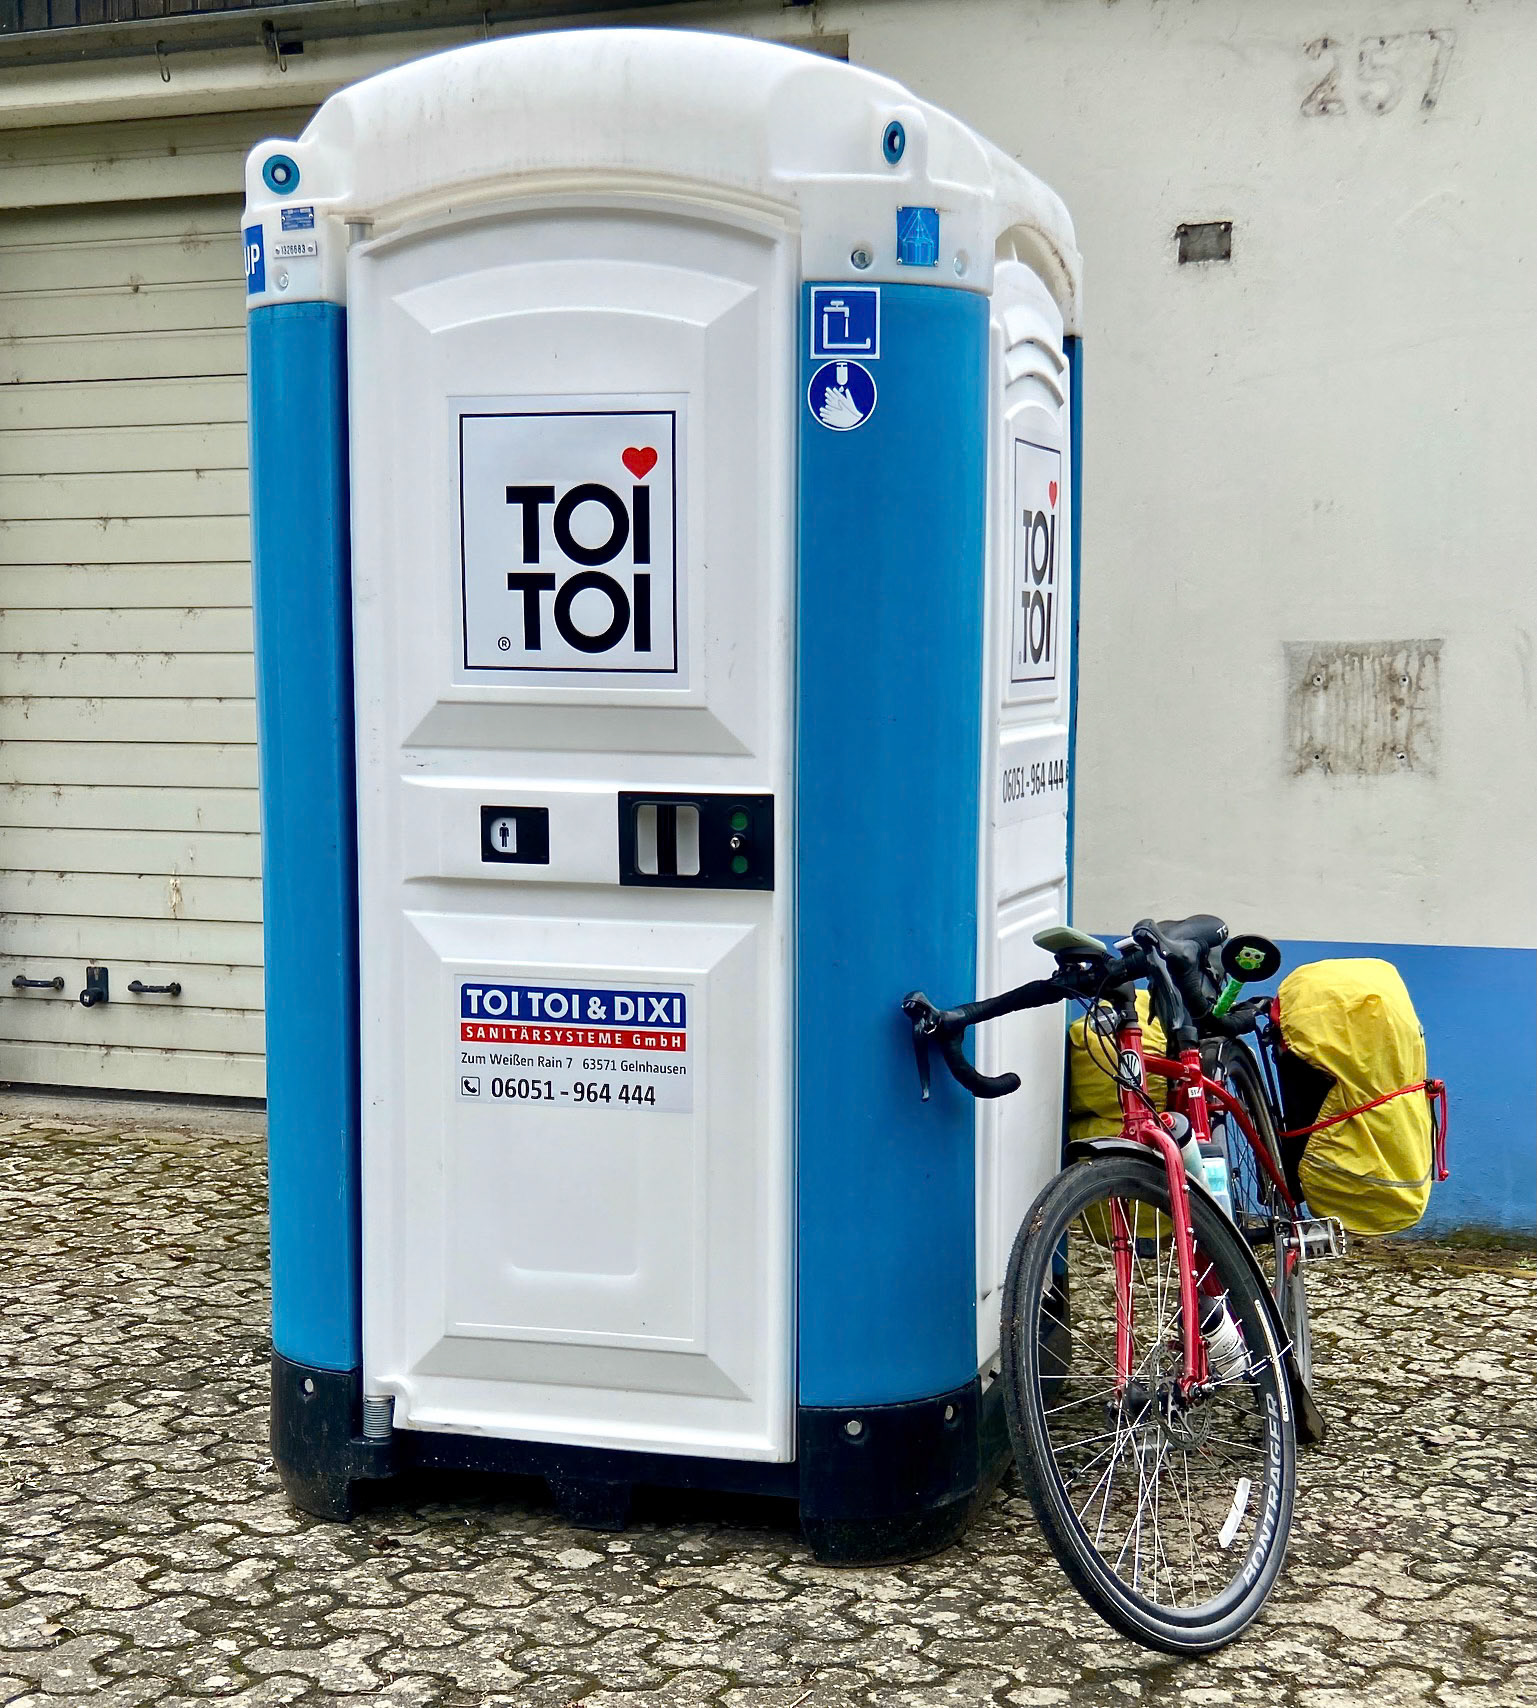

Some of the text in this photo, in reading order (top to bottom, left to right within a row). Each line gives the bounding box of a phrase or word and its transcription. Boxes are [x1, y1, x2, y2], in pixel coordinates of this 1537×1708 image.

[1300, 28, 1456, 118] 257
[506, 483, 650, 566] TOI
[1022, 509, 1055, 586] TOI
[507, 571, 651, 654] TOI
[1021, 589, 1053, 664] TOI
[465, 1025, 682, 1048] SANITÄRSYSTEME GmbH
[466, 989, 681, 1024] TOI TOI & DIXI
[461, 1052, 687, 1074] Zum Weißen Rain 7 63571 Gelnhausen
[618, 1084, 656, 1106] 444
[1242, 1392, 1282, 1588] BONTRAGER
